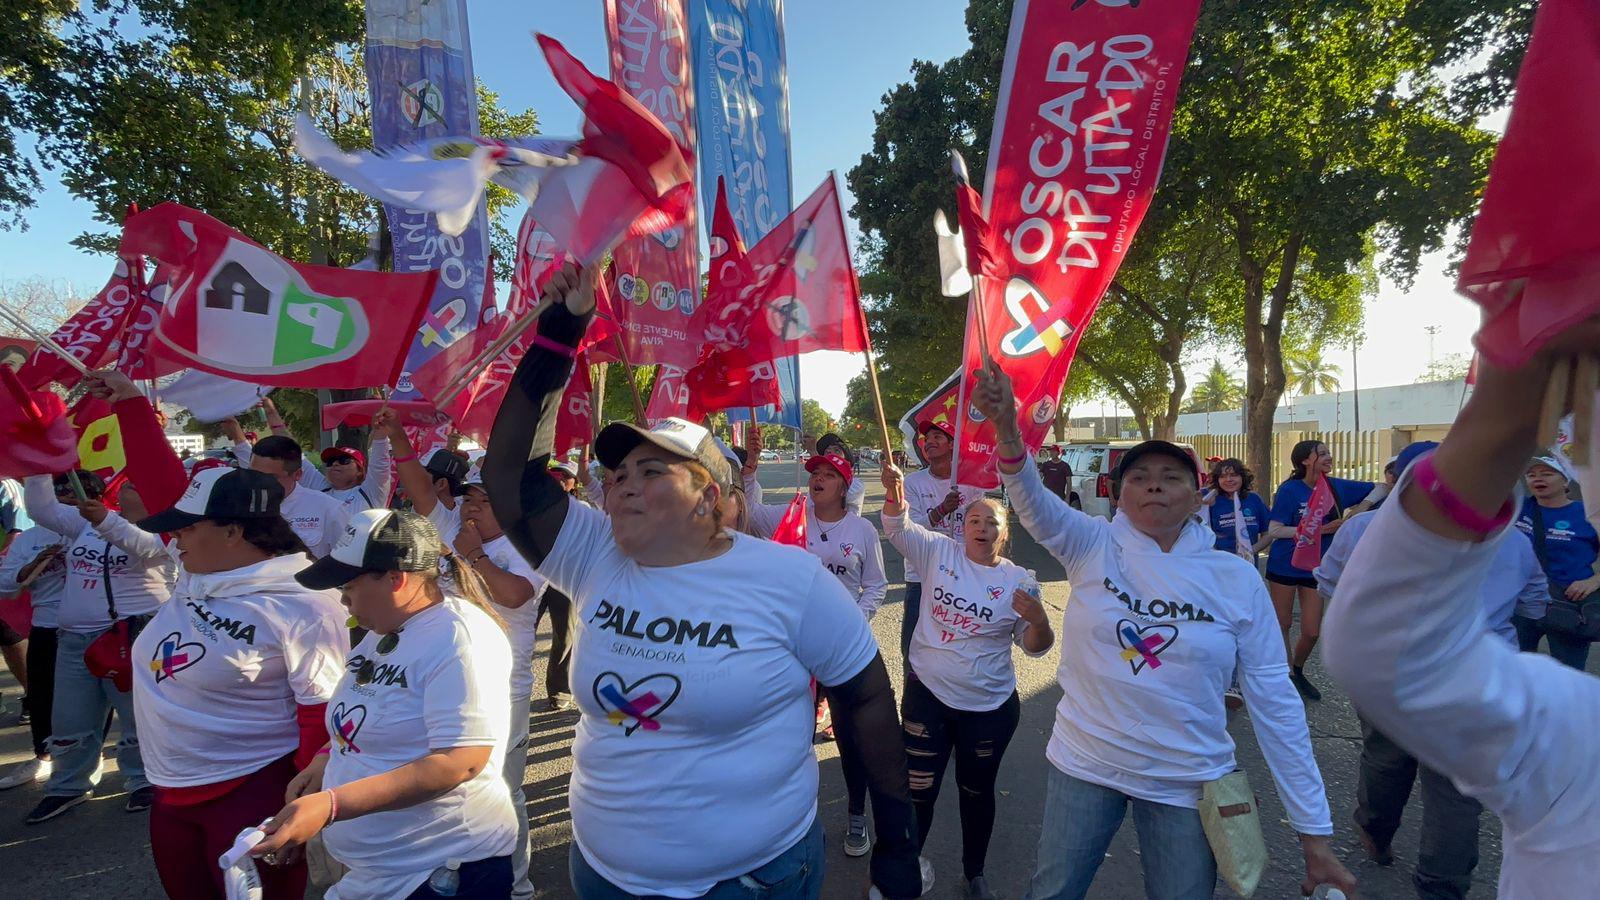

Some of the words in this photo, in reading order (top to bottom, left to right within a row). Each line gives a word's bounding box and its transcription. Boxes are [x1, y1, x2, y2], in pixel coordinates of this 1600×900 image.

[1004, 40, 1096, 266] ÓSCAR
[1056, 34, 1154, 274] DIPUTADO
[1111, 189, 1136, 254] DIPUTADO
[1130, 144, 1149, 186] LOCAL
[1142, 80, 1167, 140] DISTRITO
[82, 578, 98, 590] 11
[933, 584, 994, 623] ÓSCAR
[1102, 576, 1216, 623] PALOMA
[588, 598, 740, 650] PALOMA
[931, 601, 985, 636] VALDEZ
[610, 641, 687, 665] SENADORA
